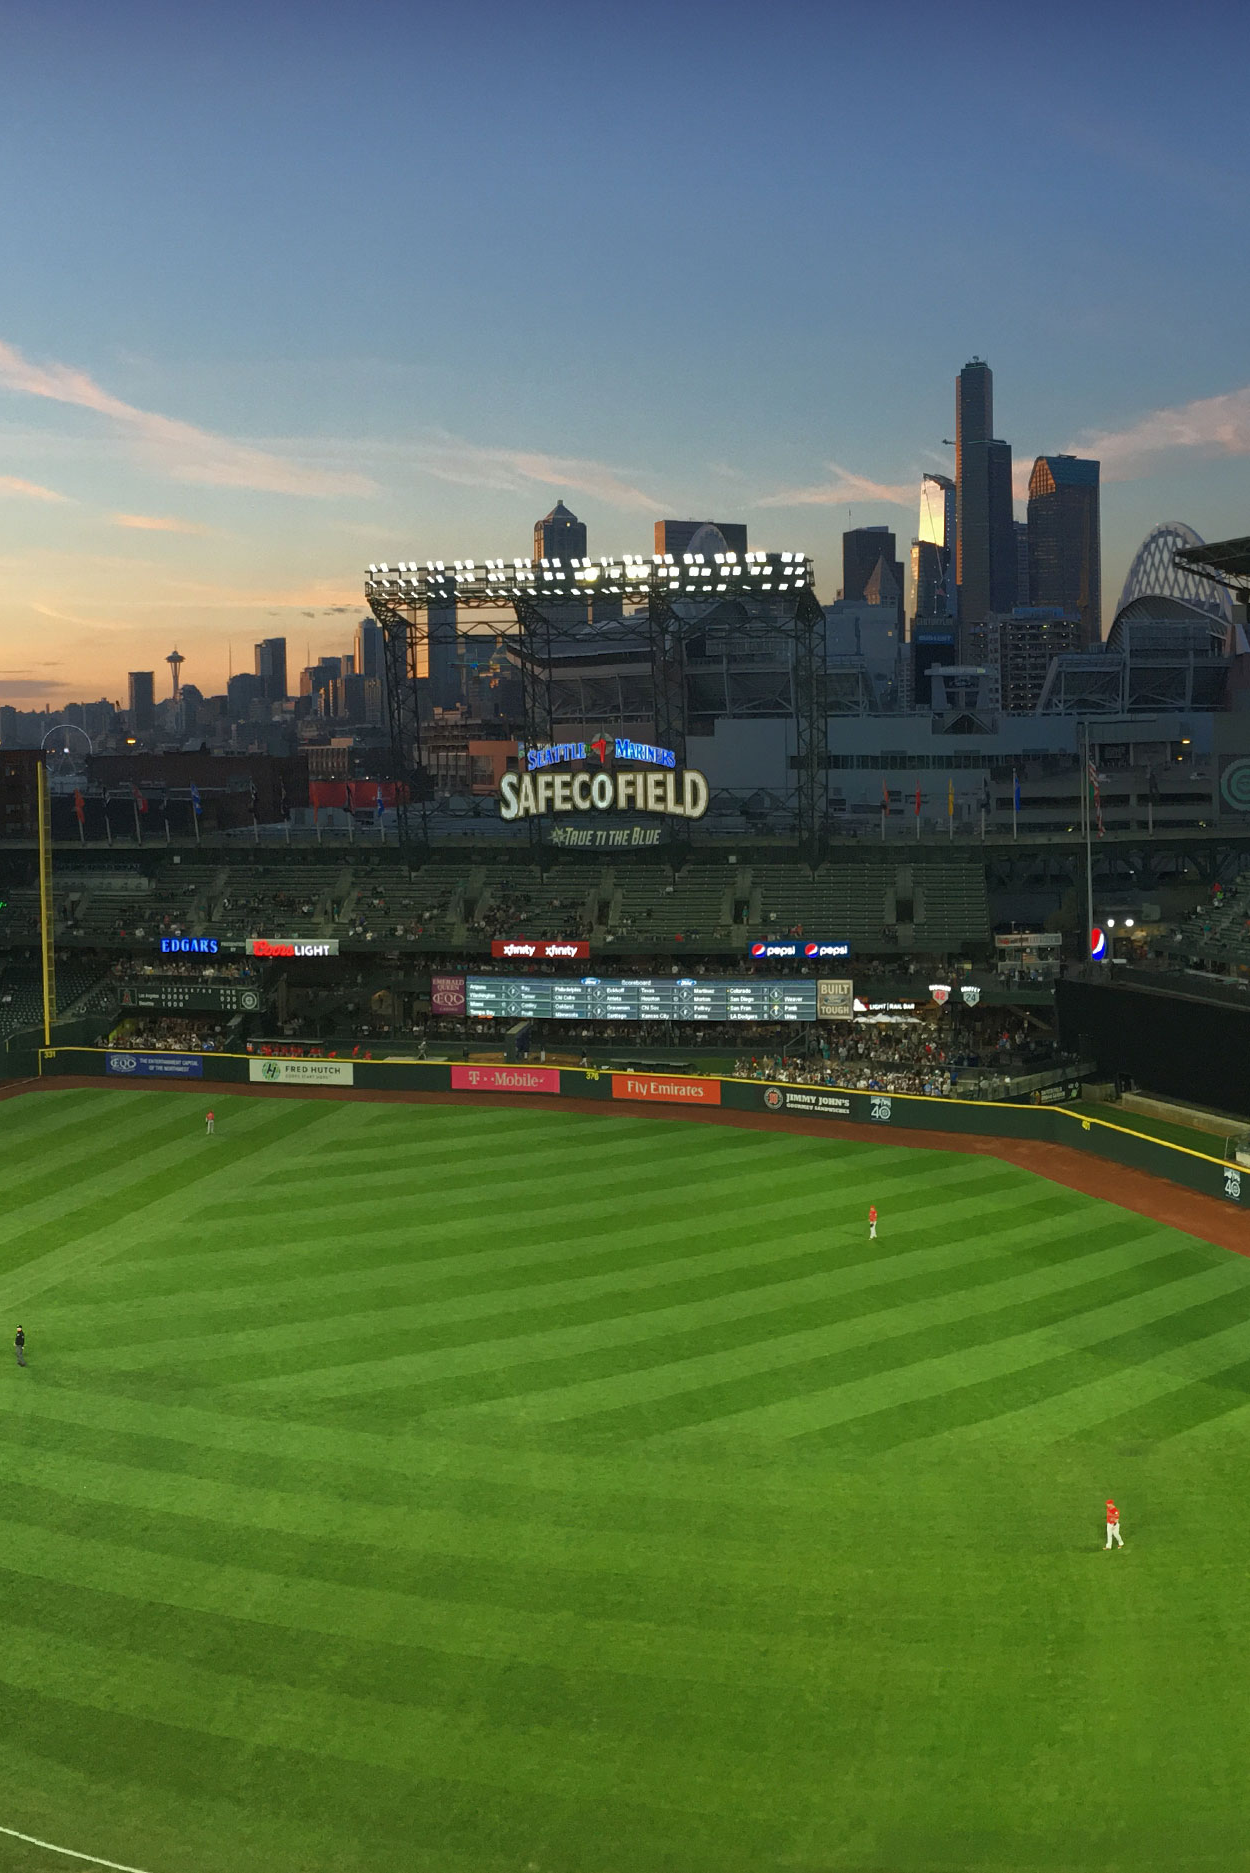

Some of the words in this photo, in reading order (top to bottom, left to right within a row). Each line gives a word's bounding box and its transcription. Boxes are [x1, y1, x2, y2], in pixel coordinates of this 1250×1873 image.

[527, 741, 587, 771] SEATTLE
[614, 738, 677, 769] MARINERS
[500, 771, 615, 821] SAFECO
[616, 769, 710, 820] FIELD
[565, 827, 593, 846] TRUE
[609, 830, 630, 846] THE
[631, 826, 661, 845] BLUE
[252, 940, 295, 957] Coors
[294, 945, 330, 957] LIGHT
[503, 944, 536, 957] xfinity
[545, 944, 578, 958] xfinity
[767, 945, 796, 957] pepsi
[819, 945, 848, 956] pepsi
[820, 984, 849, 995] BUILT
[934, 991, 946, 1000] 42
[965, 994, 976, 1002] 24
[820, 1006, 850, 1014] TOUGH
[285, 1065, 309, 1073] FRED
[310, 1066, 341, 1074] HUTCH
[627, 1080, 648, 1096] Fly
[650, 1081, 704, 1097] Emirates
[786, 1093, 817, 1104] JIMMY
[818, 1096, 850, 1107] JOHN'S
[786, 1103, 814, 1111] GOURMET
[814, 1105, 850, 1114] SANDWICHES
